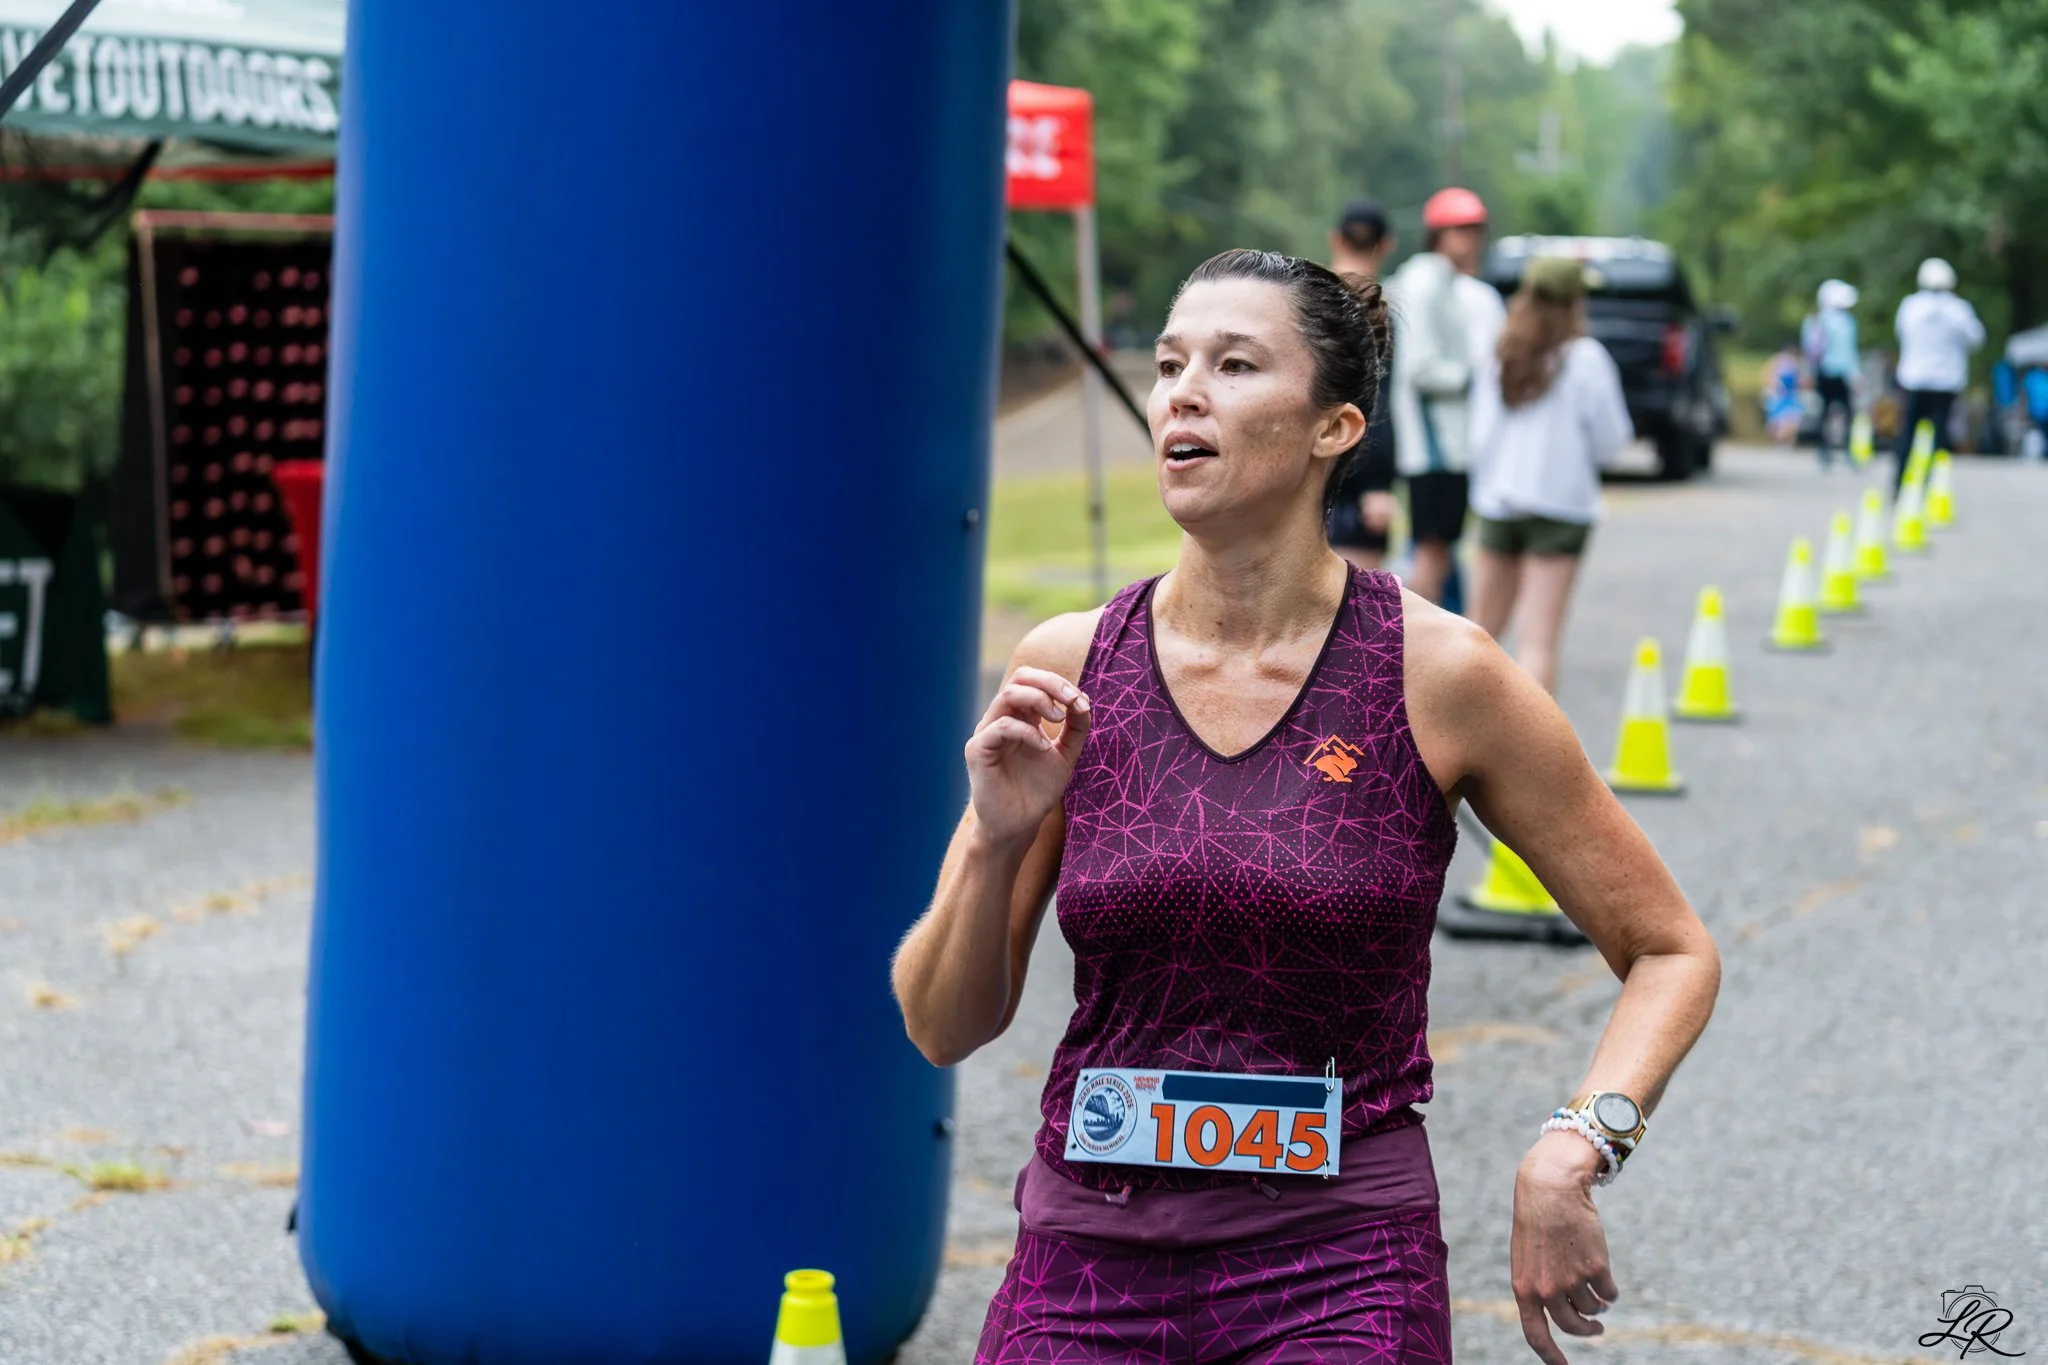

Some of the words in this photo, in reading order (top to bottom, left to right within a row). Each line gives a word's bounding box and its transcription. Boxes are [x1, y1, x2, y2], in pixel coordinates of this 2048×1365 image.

[1078, 1087, 1091, 1107] ROAD
[1090, 1077, 1104, 1090] RACE
[1106, 1077, 1125, 1092] SERIES
[1150, 1102, 1329, 1172] 1045
